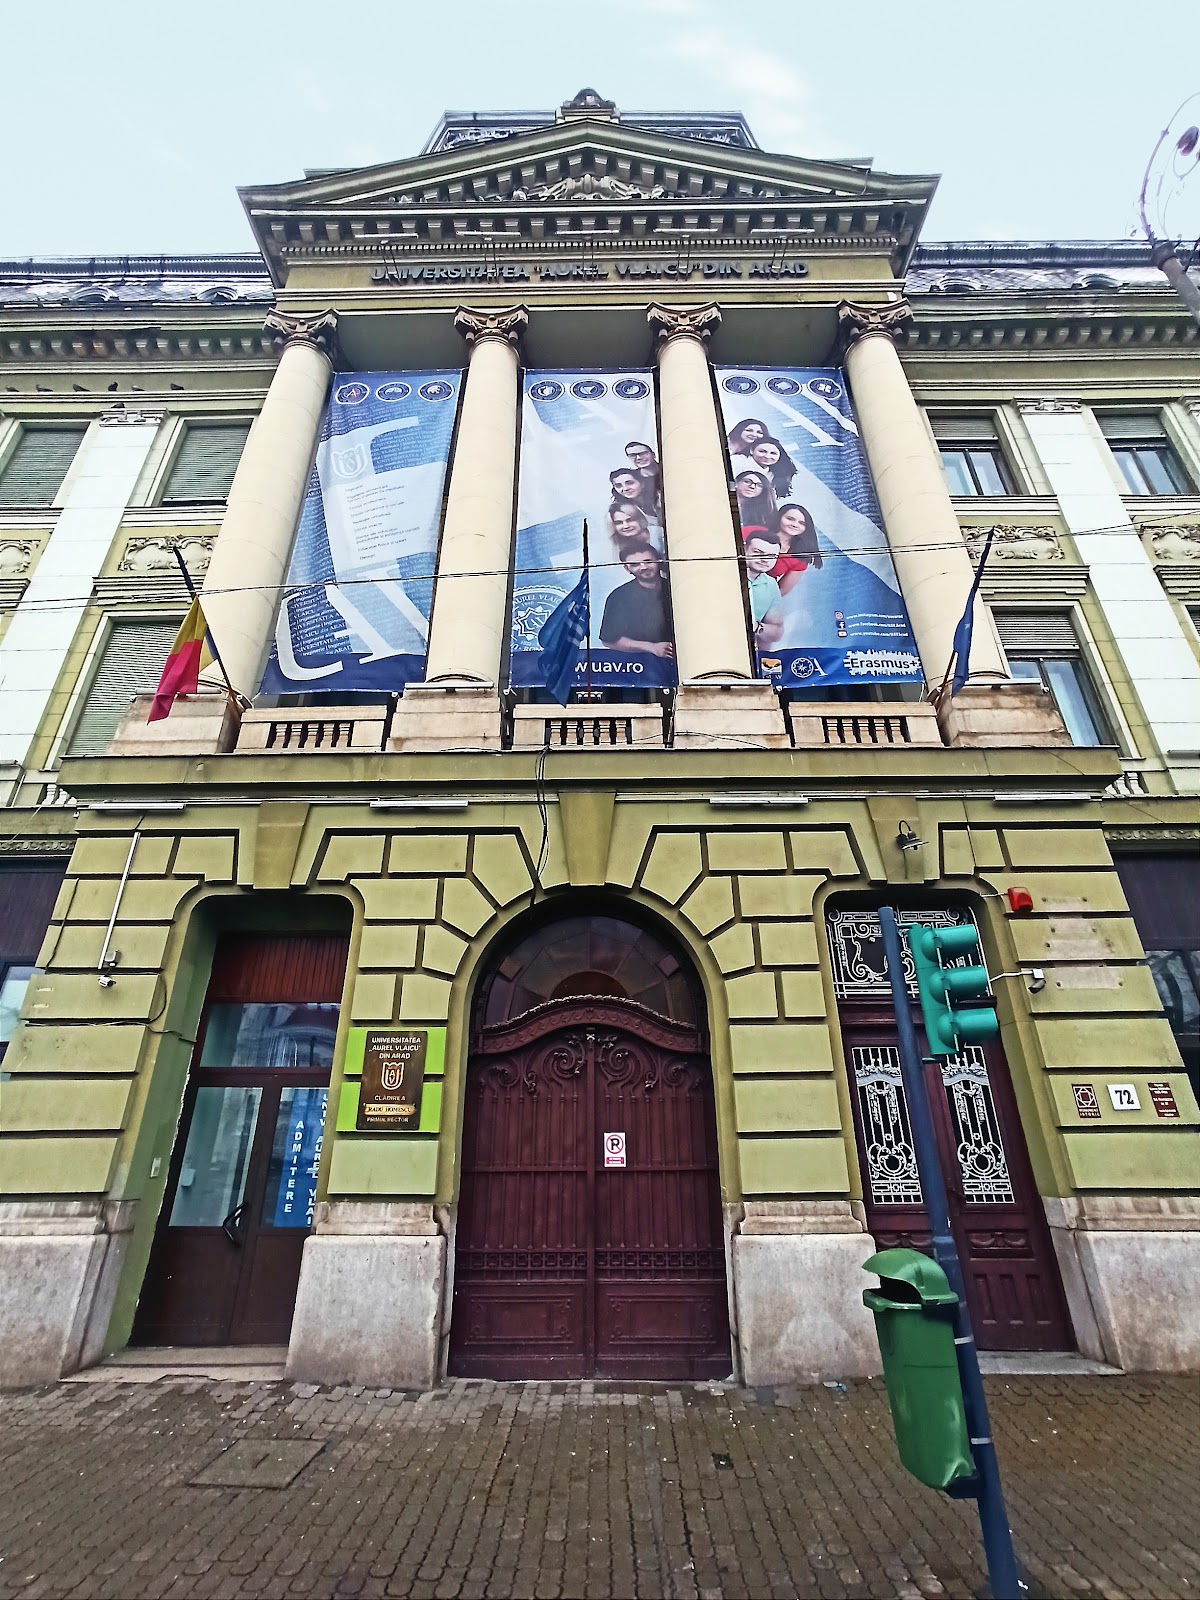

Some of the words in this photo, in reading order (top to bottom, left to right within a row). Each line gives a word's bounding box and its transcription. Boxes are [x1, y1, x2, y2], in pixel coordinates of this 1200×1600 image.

[371, 265, 531, 281] UNIVERSITATEA
[702, 262, 742, 279] DIN
[749, 261, 809, 279] ARAD
[850, 658, 918, 669] Erasmus+
[371, 1036, 421, 1044] UNIVERSITATEA
[1115, 1090, 1134, 1105] 72
[284, 1120, 304, 1213] ADMITERE
